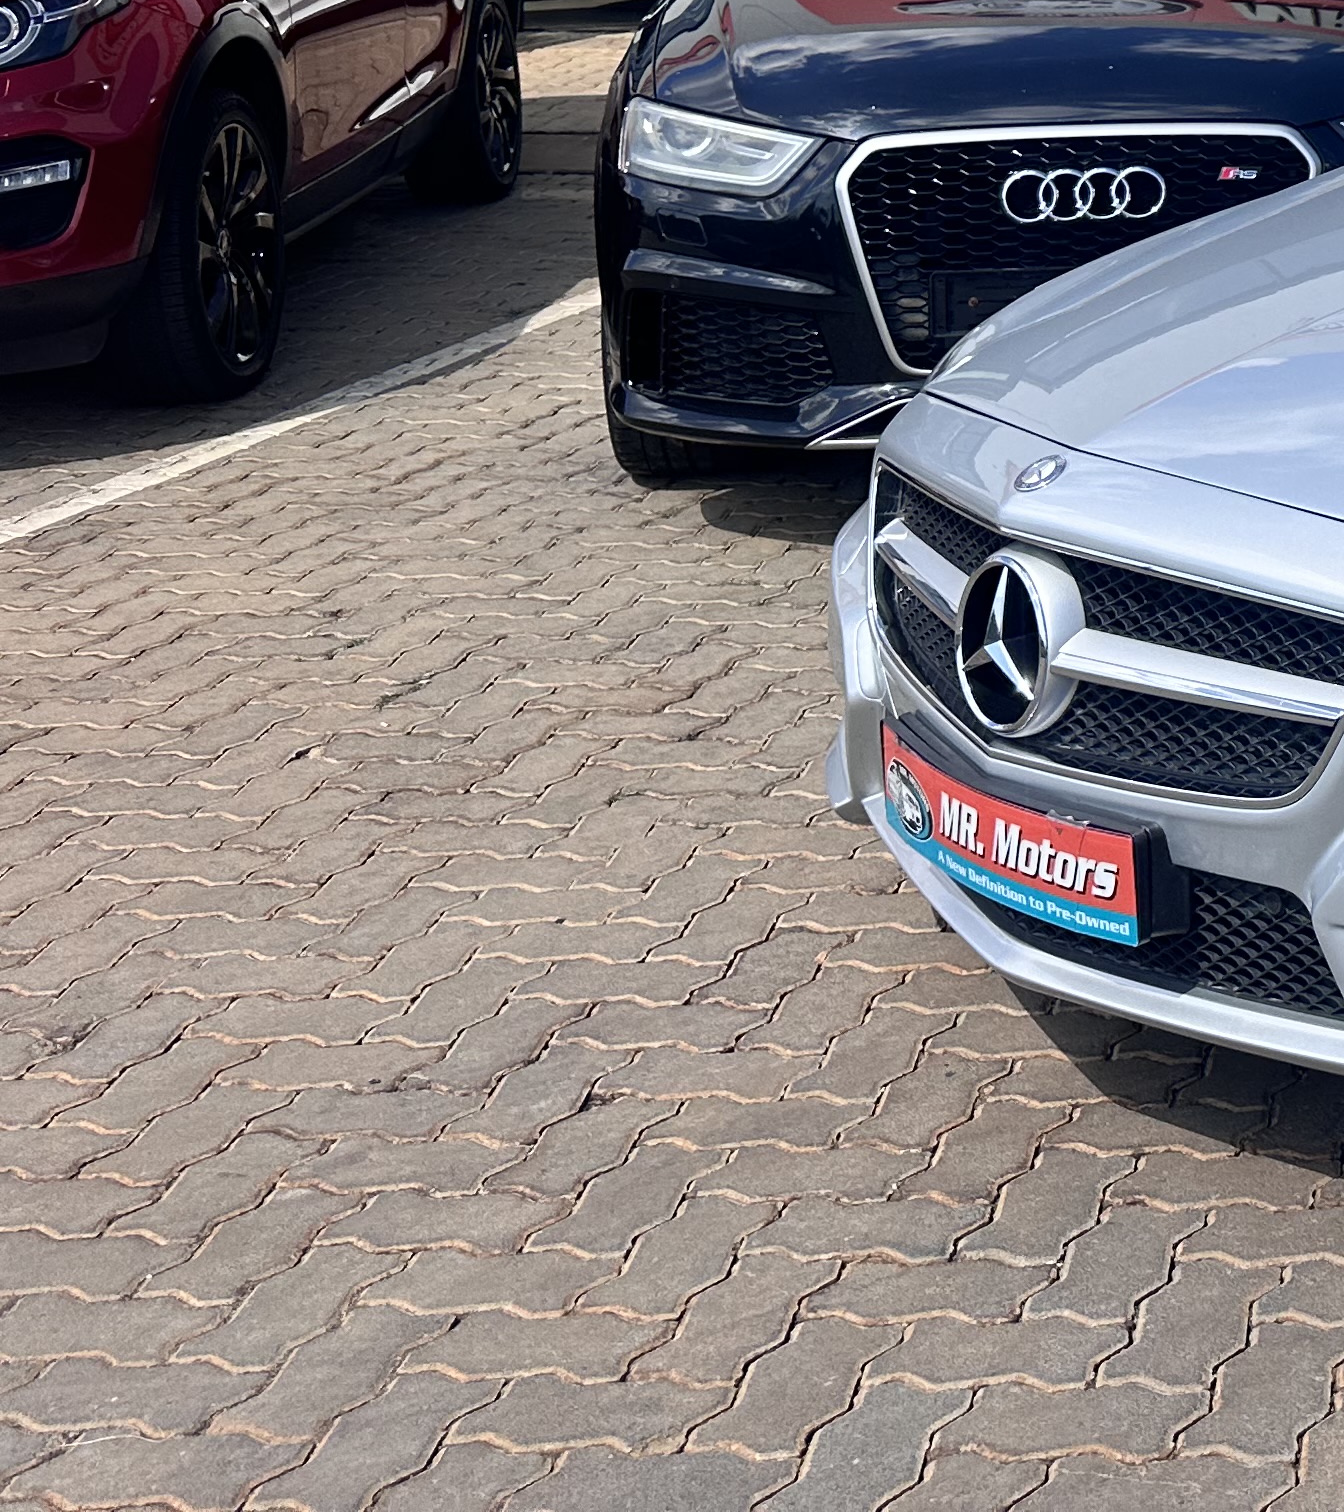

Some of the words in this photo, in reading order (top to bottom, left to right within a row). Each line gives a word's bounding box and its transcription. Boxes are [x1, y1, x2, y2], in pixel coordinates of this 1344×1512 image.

[937, 849, 946, 865] A
[945, 854, 967, 877] New
[967, 867, 1027, 905] Definition
[1029, 895, 1044, 911] to
[1046, 900, 1130, 936] Pre-Owned
[938, 791, 985, 858] MR.
[991, 819, 1119, 900] Motors
